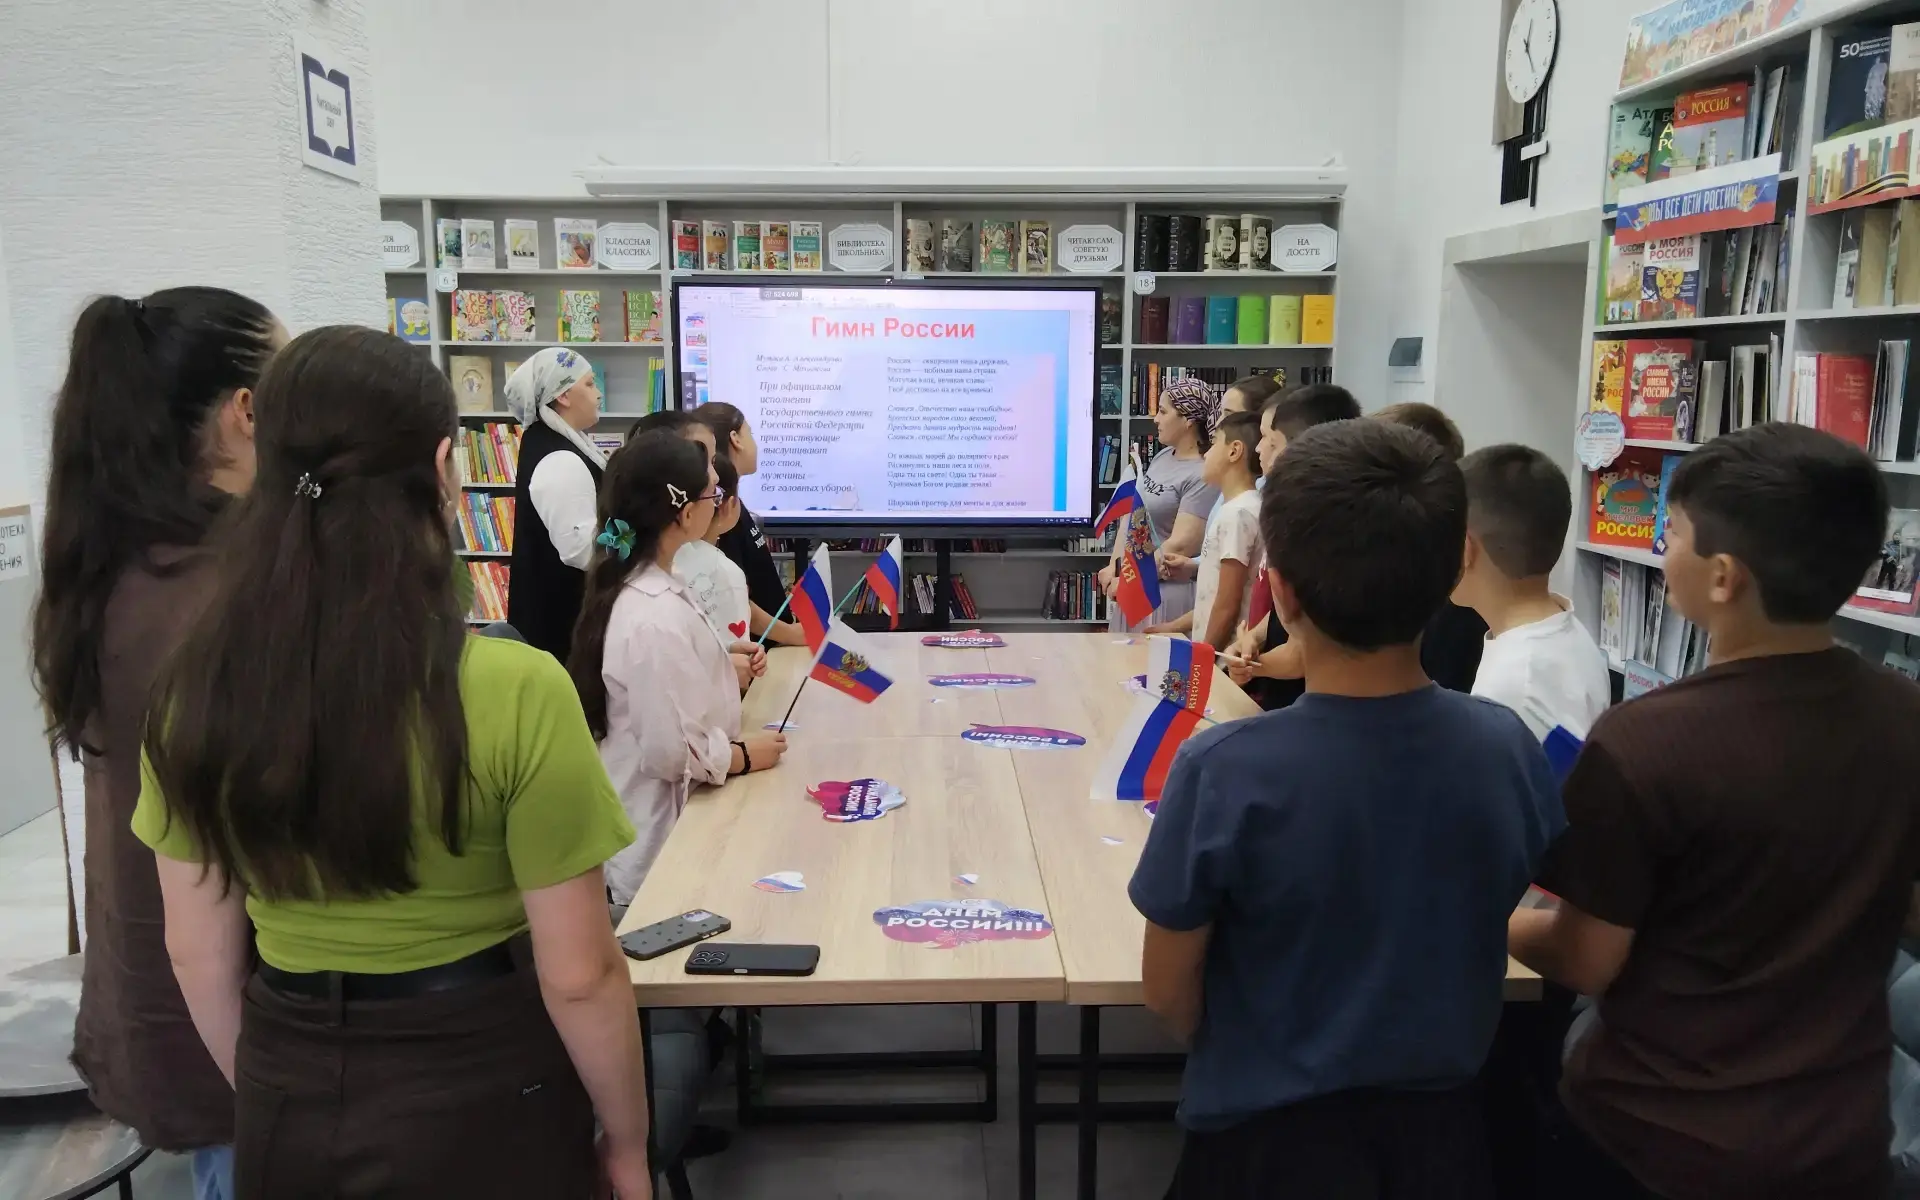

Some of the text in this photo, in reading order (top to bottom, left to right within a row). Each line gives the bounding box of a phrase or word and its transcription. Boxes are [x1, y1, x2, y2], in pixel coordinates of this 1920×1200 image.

[1840, 43, 1859, 58] 50
[1691, 96, 1730, 116] РОССИЯ
[1649, 200, 1663, 221] МЫ
[1665, 198, 1680, 219] ВСЕ
[1682, 193, 1701, 217] ДЕТИ
[382, 235, 394, 243] ЛЯ
[605, 238, 651, 246] КЛАССНАЯ
[1067, 237, 1095, 245] ЧИТАЮ
[1297, 238, 1310, 246] НА
[1659, 237, 1685, 248] МОЯ
[837, 240, 885, 248] БИБЛИОТЕКА
[605, 248, 651, 256] КЛАССИКА
[1286, 248, 1320, 257] ДОСУГЕ
[1649, 247, 1694, 260] РОССИЯ
[1073, 255, 1108, 263] ДРУЗЬЯМ
[1139, 279, 1155, 288] 18+
[812, 316, 975, 338] Гимн России
[1647, 378, 1667, 386] ИМЕНА
[760, 381, 842, 393] При официальном
[1642, 388, 1670, 398] РОССИИ
[761, 407, 844, 418] Государственного
[761, 420, 865, 431] Российской Федерации
[760, 435, 840, 443] присутствующие
[763, 447, 828, 456] выслушивают
[761, 473, 806, 481] мужчины
[761, 484, 775, 492] без
[0, 523, 26, 539] ОТЕКА
[1596, 521, 1656, 539] РОССИЯ
[887, 917, 1043, 932] РОССИИ!!!
